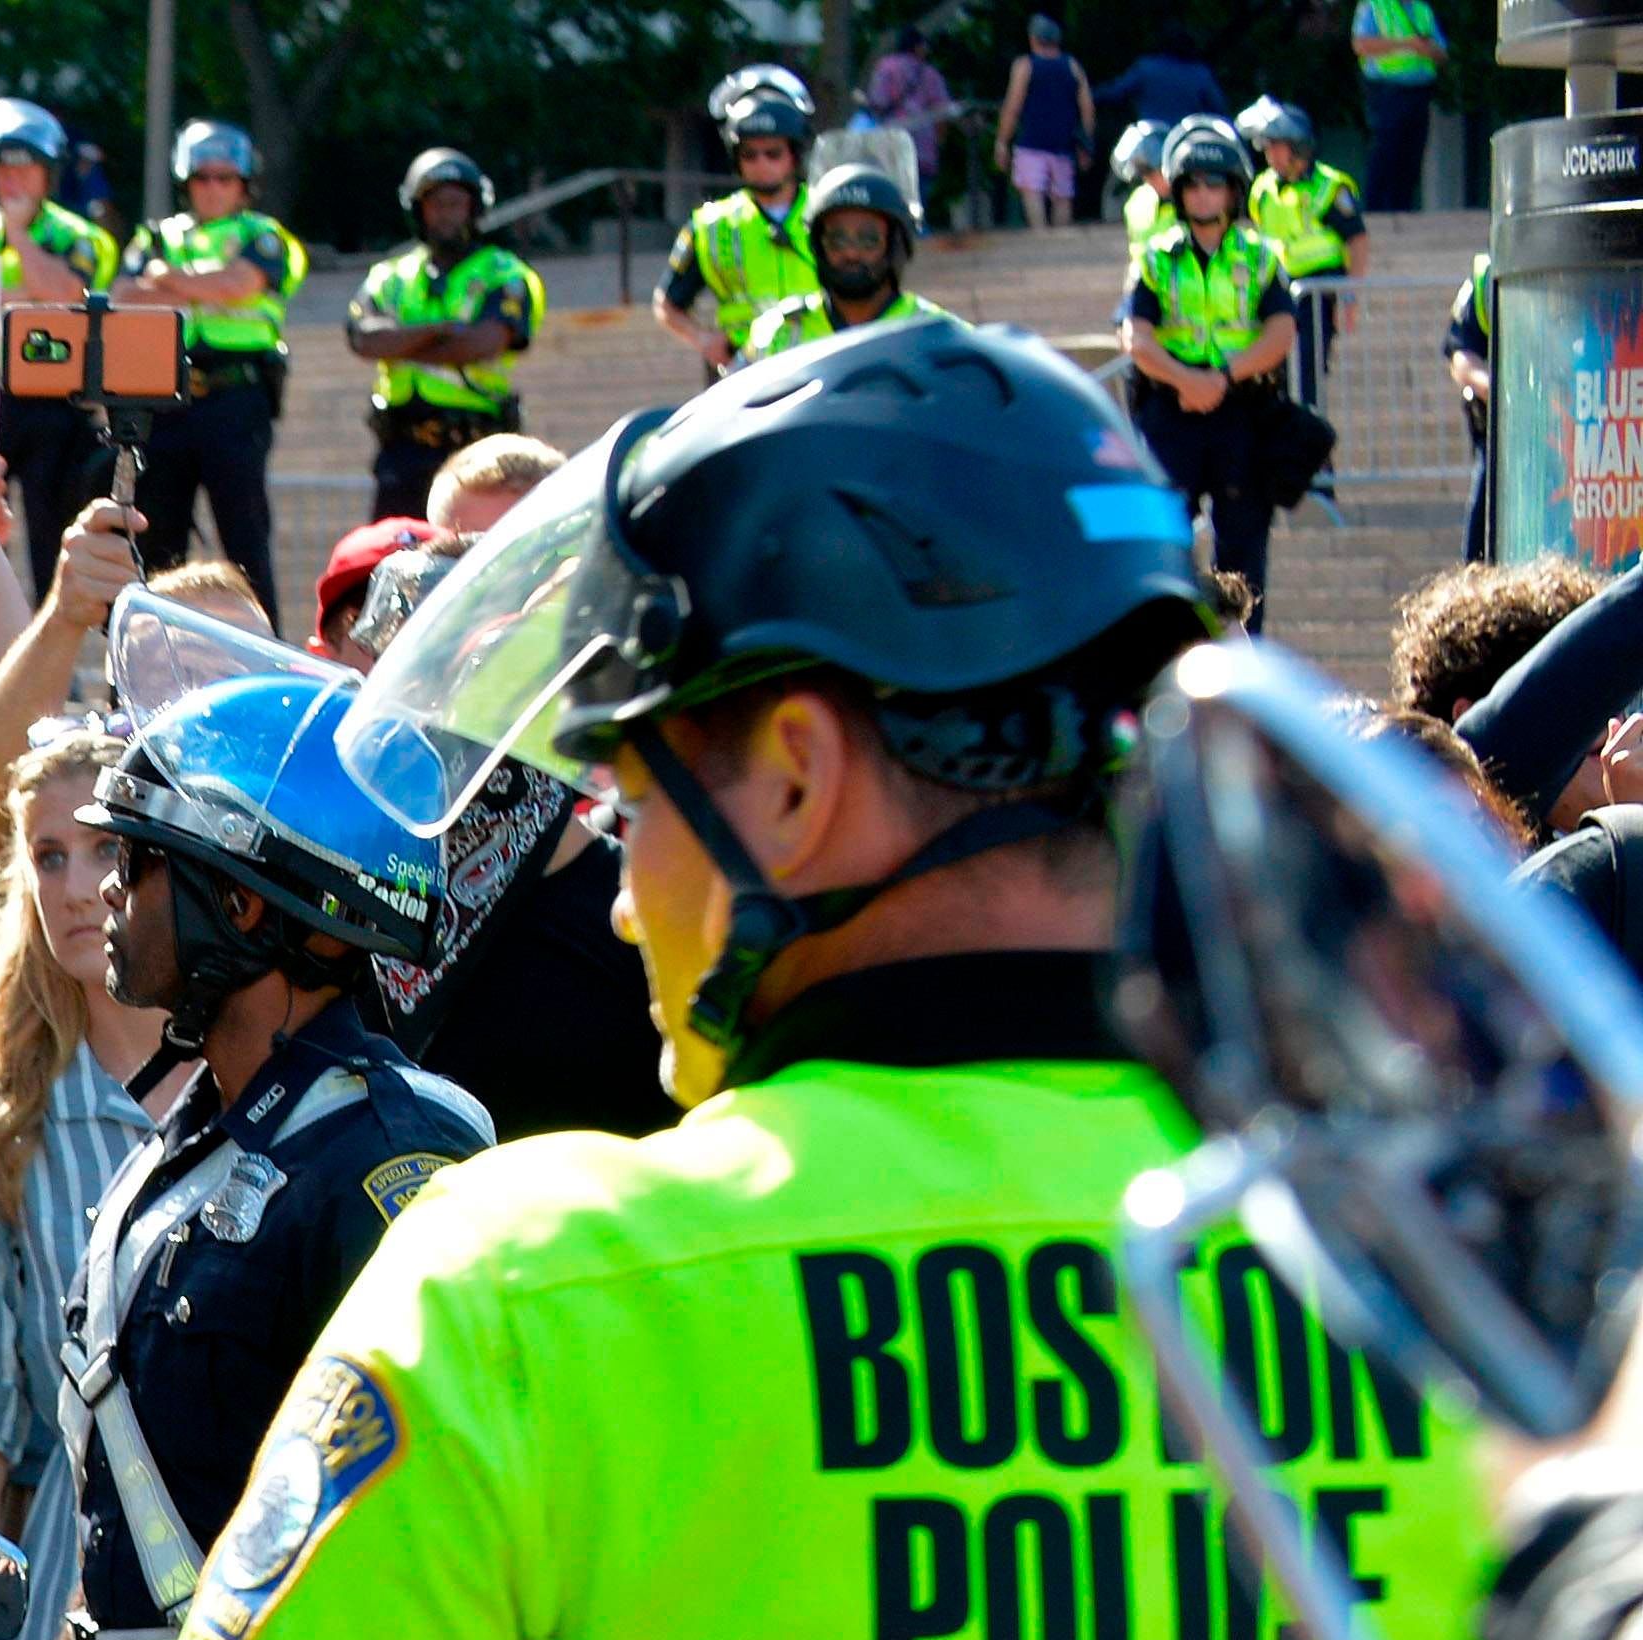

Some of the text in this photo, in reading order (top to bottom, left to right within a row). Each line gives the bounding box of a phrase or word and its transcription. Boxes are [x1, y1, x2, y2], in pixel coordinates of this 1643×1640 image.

[1562, 144, 1636, 177] JCDecaux
[1576, 368, 1643, 420] BLUE
[1574, 421, 1643, 480] MAN
